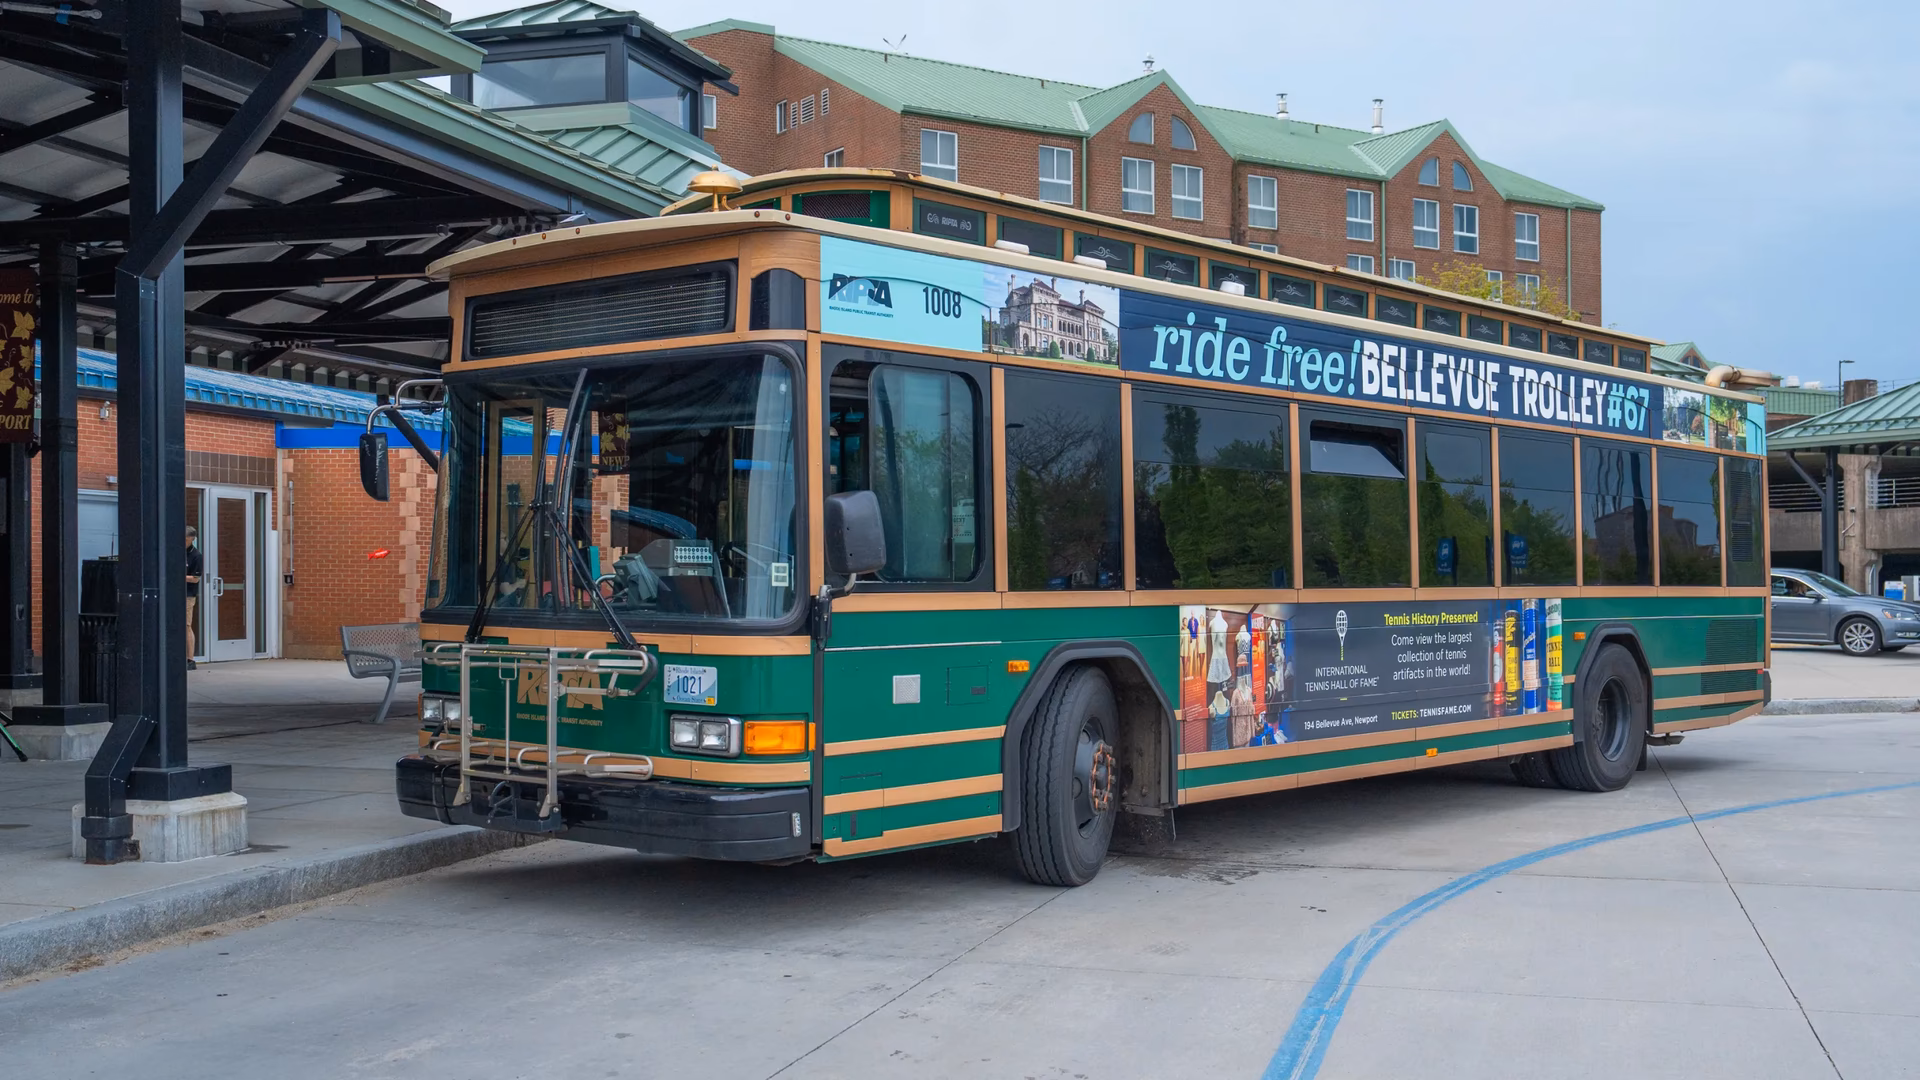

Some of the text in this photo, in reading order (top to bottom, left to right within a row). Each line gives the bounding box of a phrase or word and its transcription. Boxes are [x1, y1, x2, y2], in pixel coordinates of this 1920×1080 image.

[23, 288, 34, 304] to
[828, 273, 892, 308] RIPTA
[923, 286, 961, 318] 1008
[1149, 312, 1650, 431] ride free! BELLEVUE TROLLEY #67
[1384, 611, 1478, 626] Tennis History Preserved
[1391, 631, 1472, 646] Come view the largest
[1398, 648, 1466, 663] collection of tennis
[1315, 665, 1368, 677] INTERNATIONAL
[1393, 664, 1470, 680] artifacts in the world!
[677, 675, 702, 694] 1021
[1305, 681, 1329, 692] TENNIS
[1331, 680, 1348, 690] HALL
[1349, 679, 1359, 688] OF
[1391, 704, 1472, 720] TICKETS: TENNISFAME.COM
[1304, 715, 1378, 730] 194 Bellevue Ave, Newport
